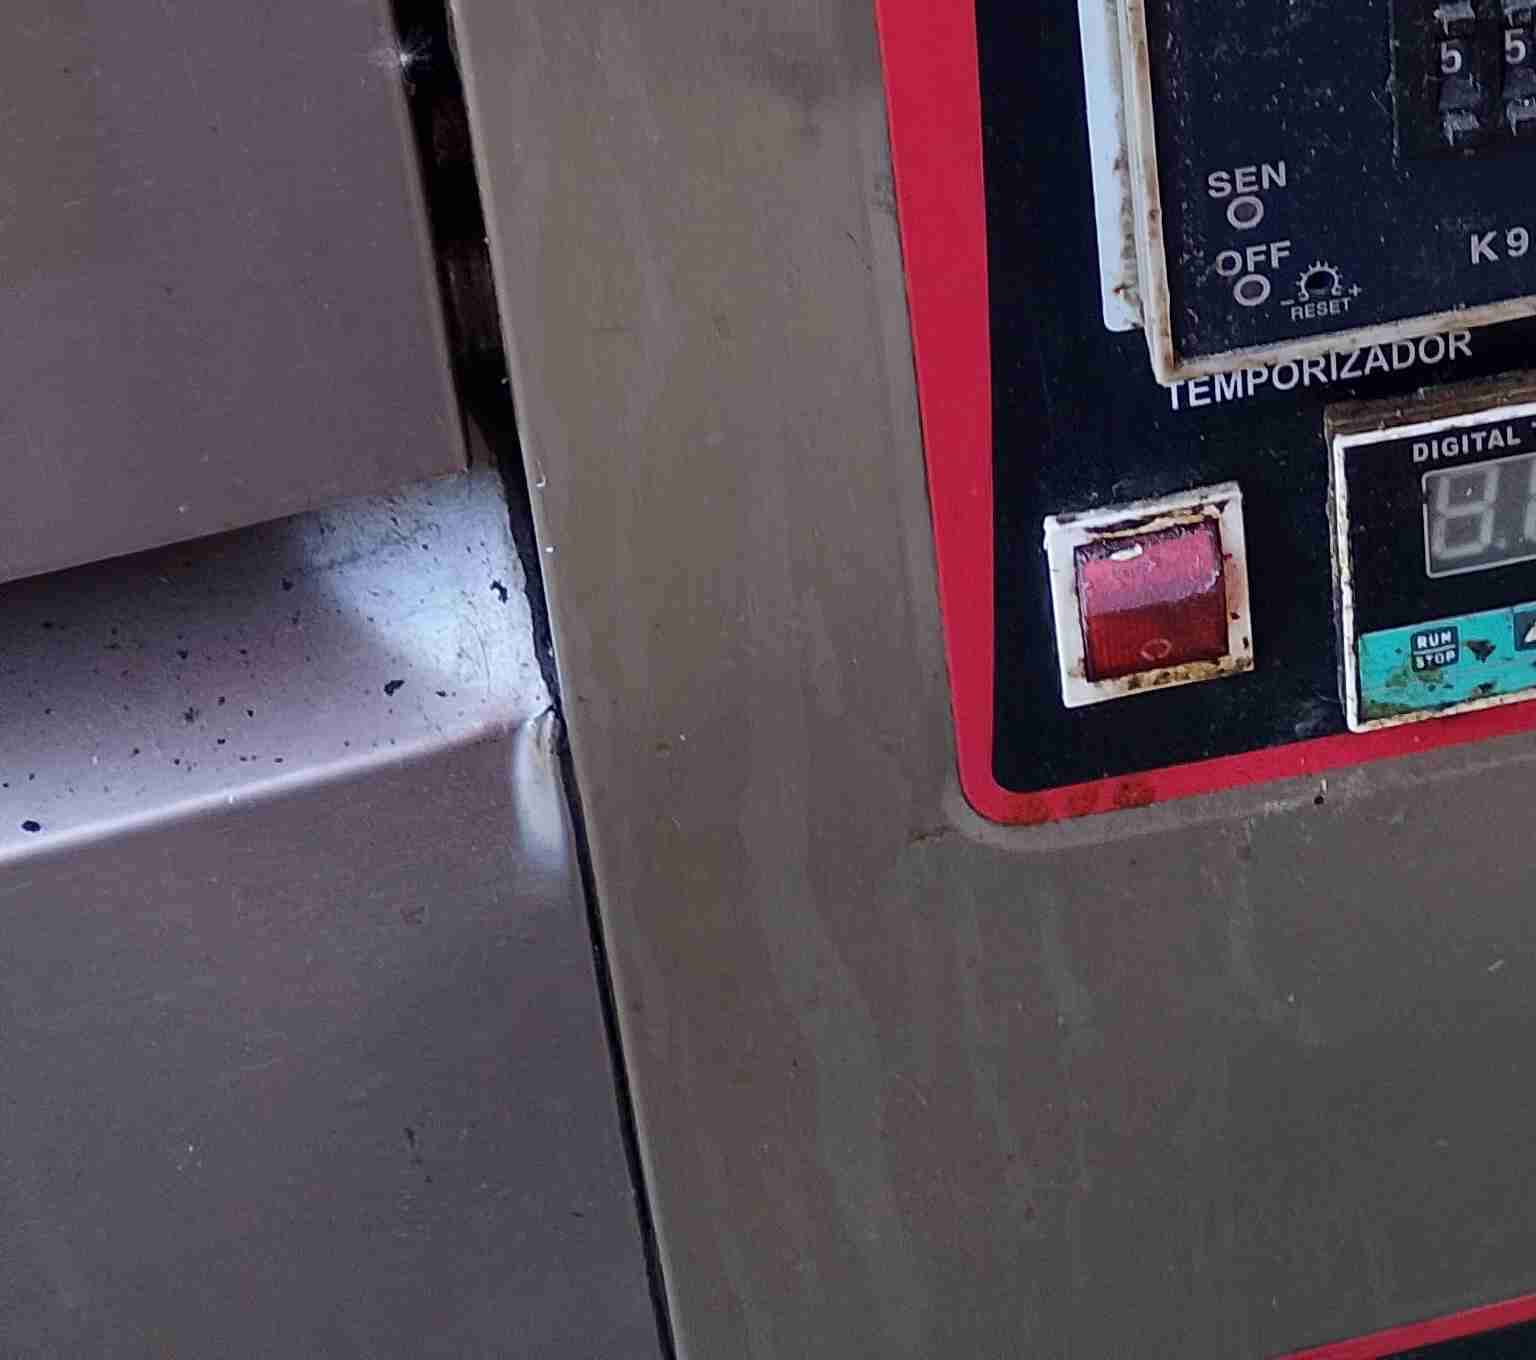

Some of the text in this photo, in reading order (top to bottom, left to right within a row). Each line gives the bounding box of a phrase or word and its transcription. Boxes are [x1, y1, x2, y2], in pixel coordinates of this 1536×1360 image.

[1205, 159, 1289, 197] SEN
[1213, 238, 1292, 278] OFF
[1288, 293, 1354, 322] RESET
[1166, 328, 1474, 411] TEMPORIZADOR
[1411, 425, 1522, 463] DIGITAL
[1415, 629, 1453, 650] RUN
[1415, 649, 1457, 670] STOP
